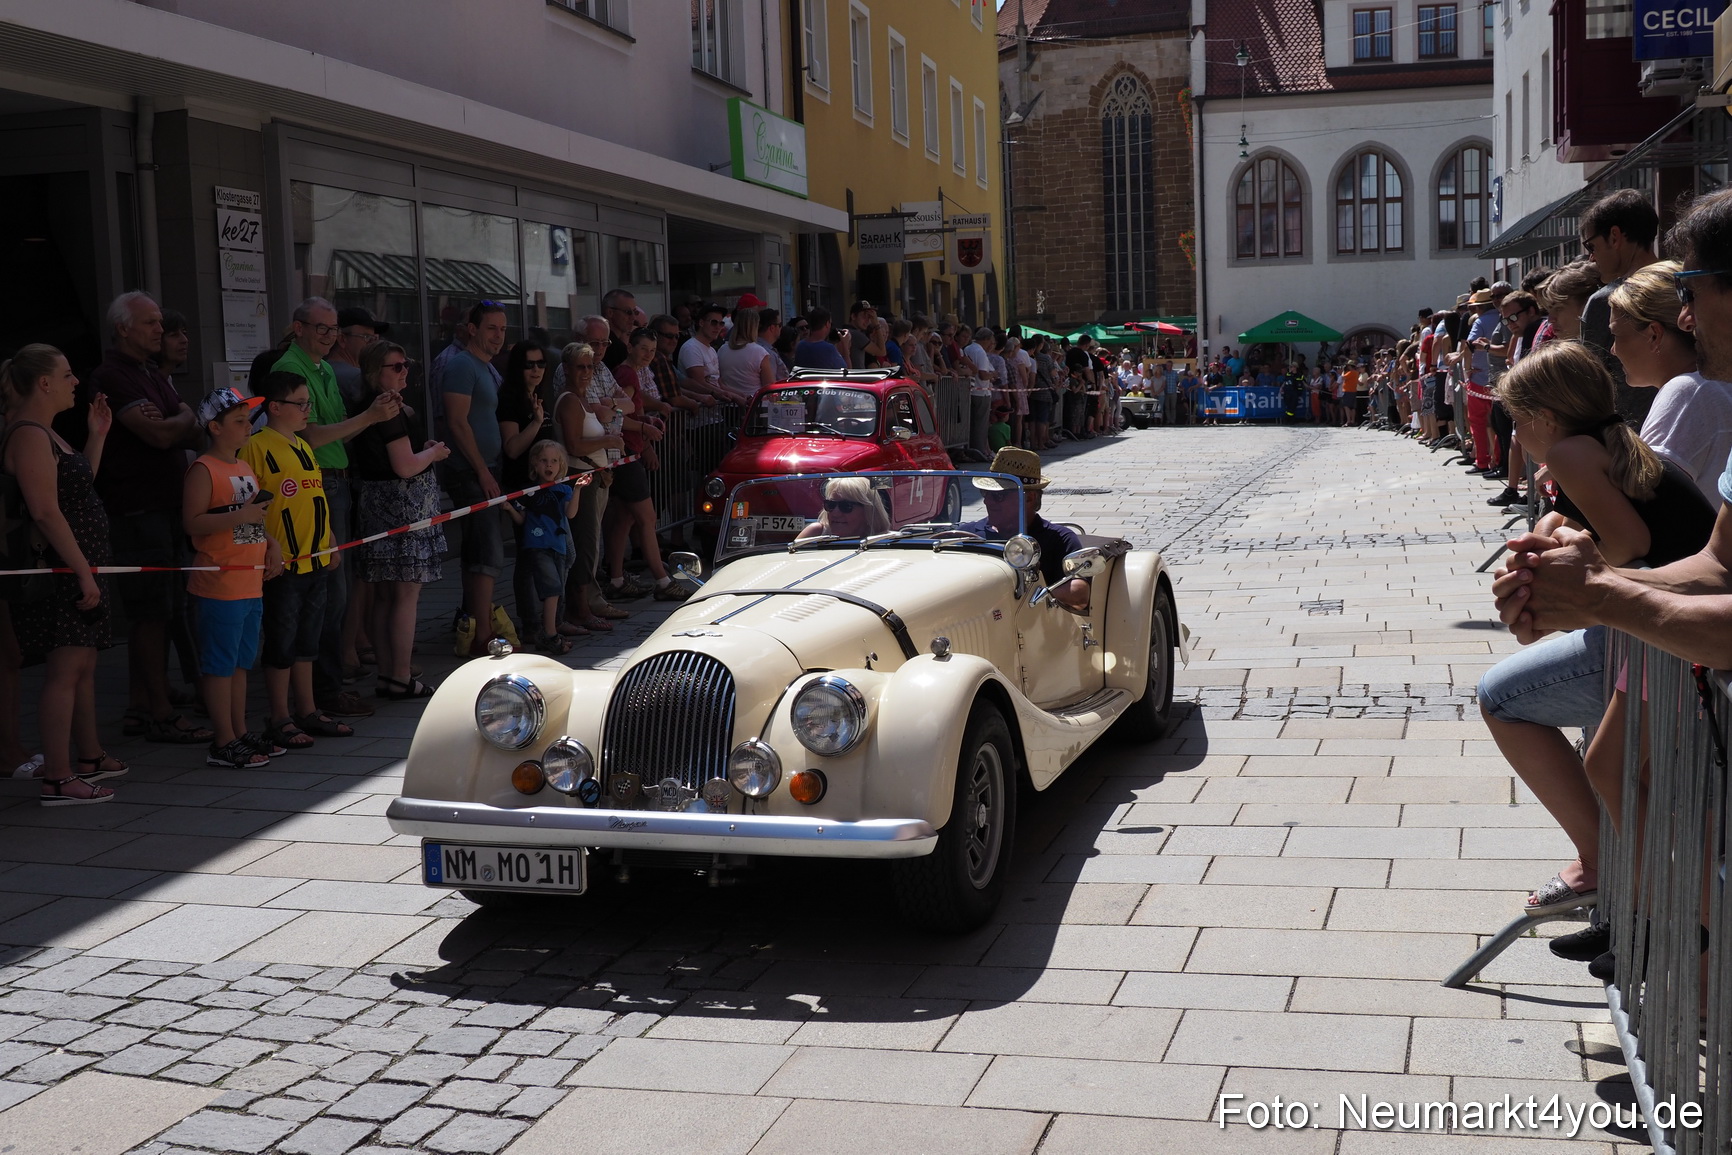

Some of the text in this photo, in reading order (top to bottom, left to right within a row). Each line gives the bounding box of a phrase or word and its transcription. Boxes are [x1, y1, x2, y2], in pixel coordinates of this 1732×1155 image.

[1643, 7, 1713, 31] CECIL
[216, 188, 260, 206] Klostergasse 27
[953, 217, 982, 226] RATHAUS
[860, 232, 901, 245] SARAH K
[780, 389, 798, 397] Fiat
[816, 389, 837, 397] Club
[838, 391, 866, 399] Italia
[786, 409, 798, 417] 107
[908, 476, 924, 505] 74
[762, 517, 770, 529] F
[772, 517, 795, 529] 574
[663, 786, 677, 796] MCD
[445, 849, 477, 880] NM
[431, 866, 438, 876] D
